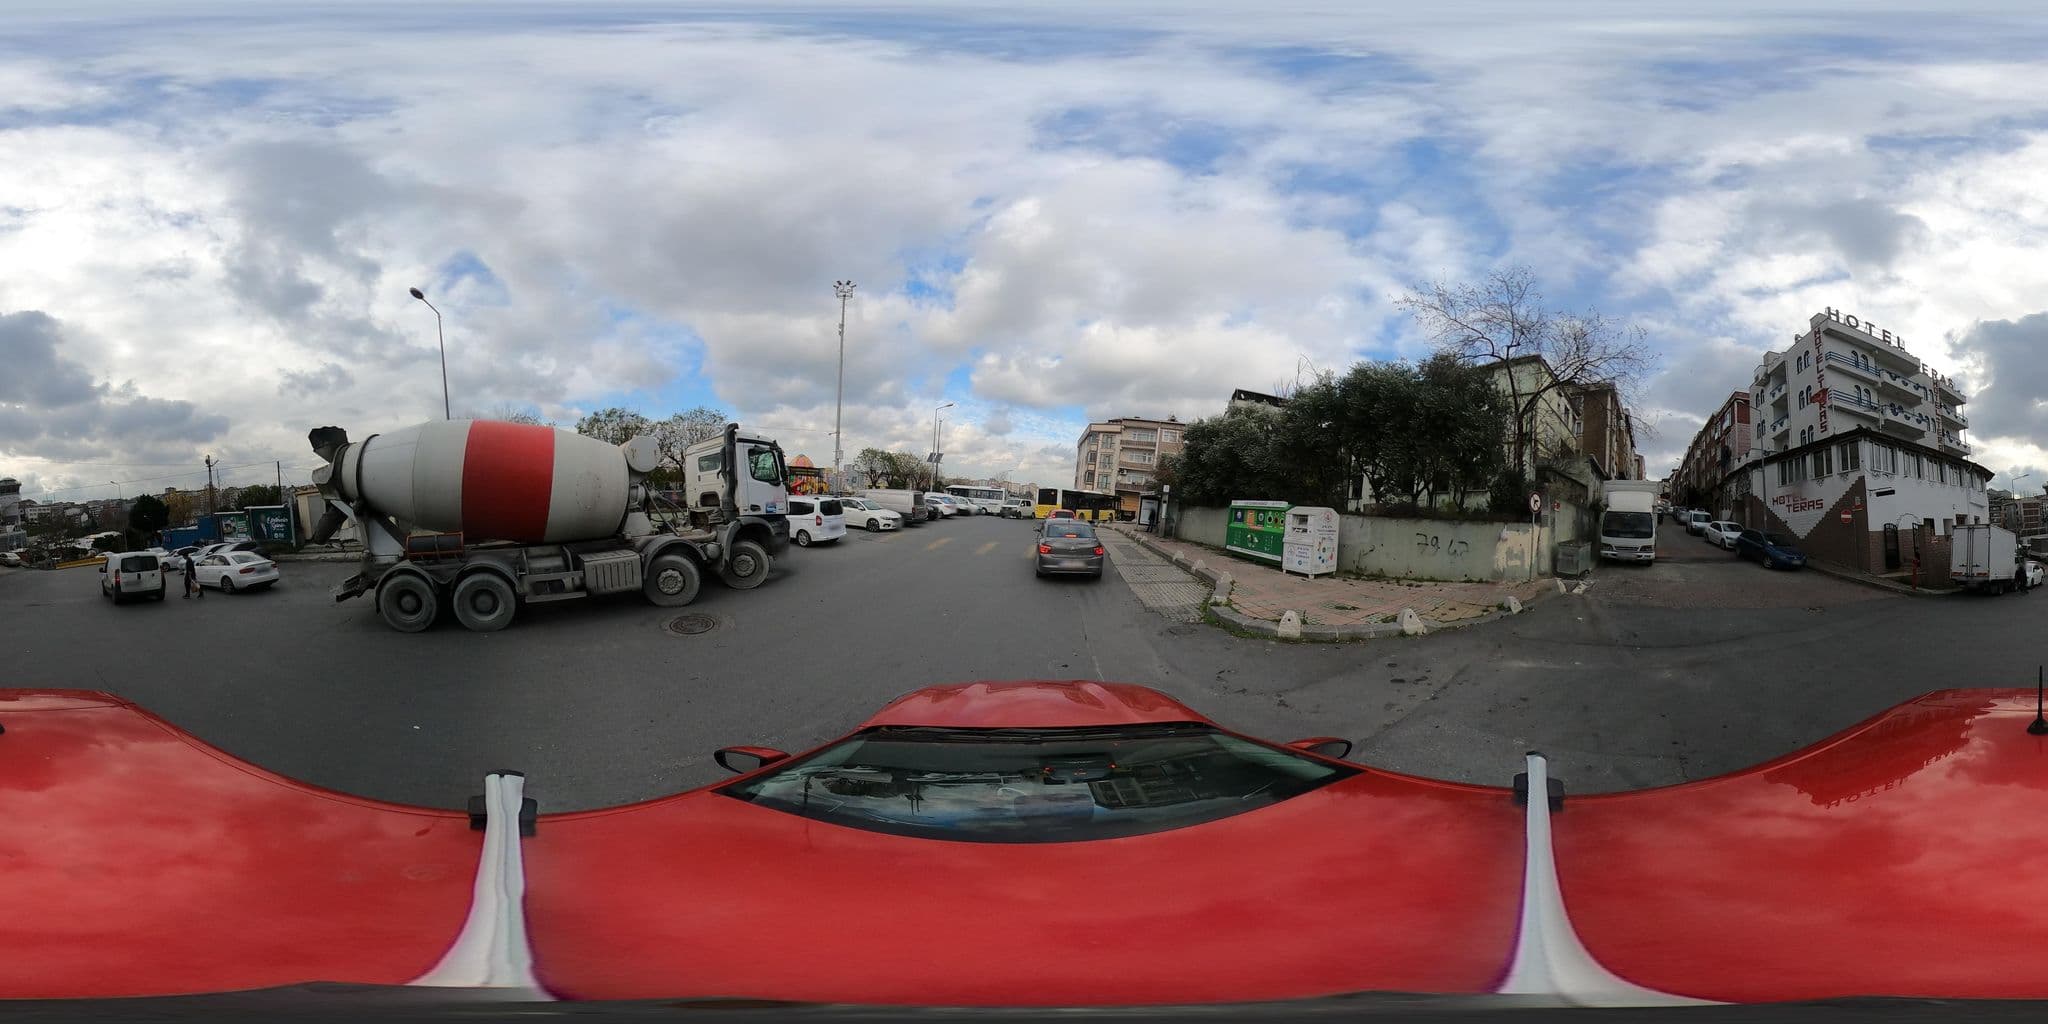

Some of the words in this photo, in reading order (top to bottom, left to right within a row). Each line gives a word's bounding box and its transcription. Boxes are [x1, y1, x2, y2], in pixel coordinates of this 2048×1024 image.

[1825, 306, 1905, 352] HOTEL
[1921, 362, 1954, 389] ERAS
[1772, 495, 1807, 506] HOTEL
[1786, 499, 1824, 513] TERAS
